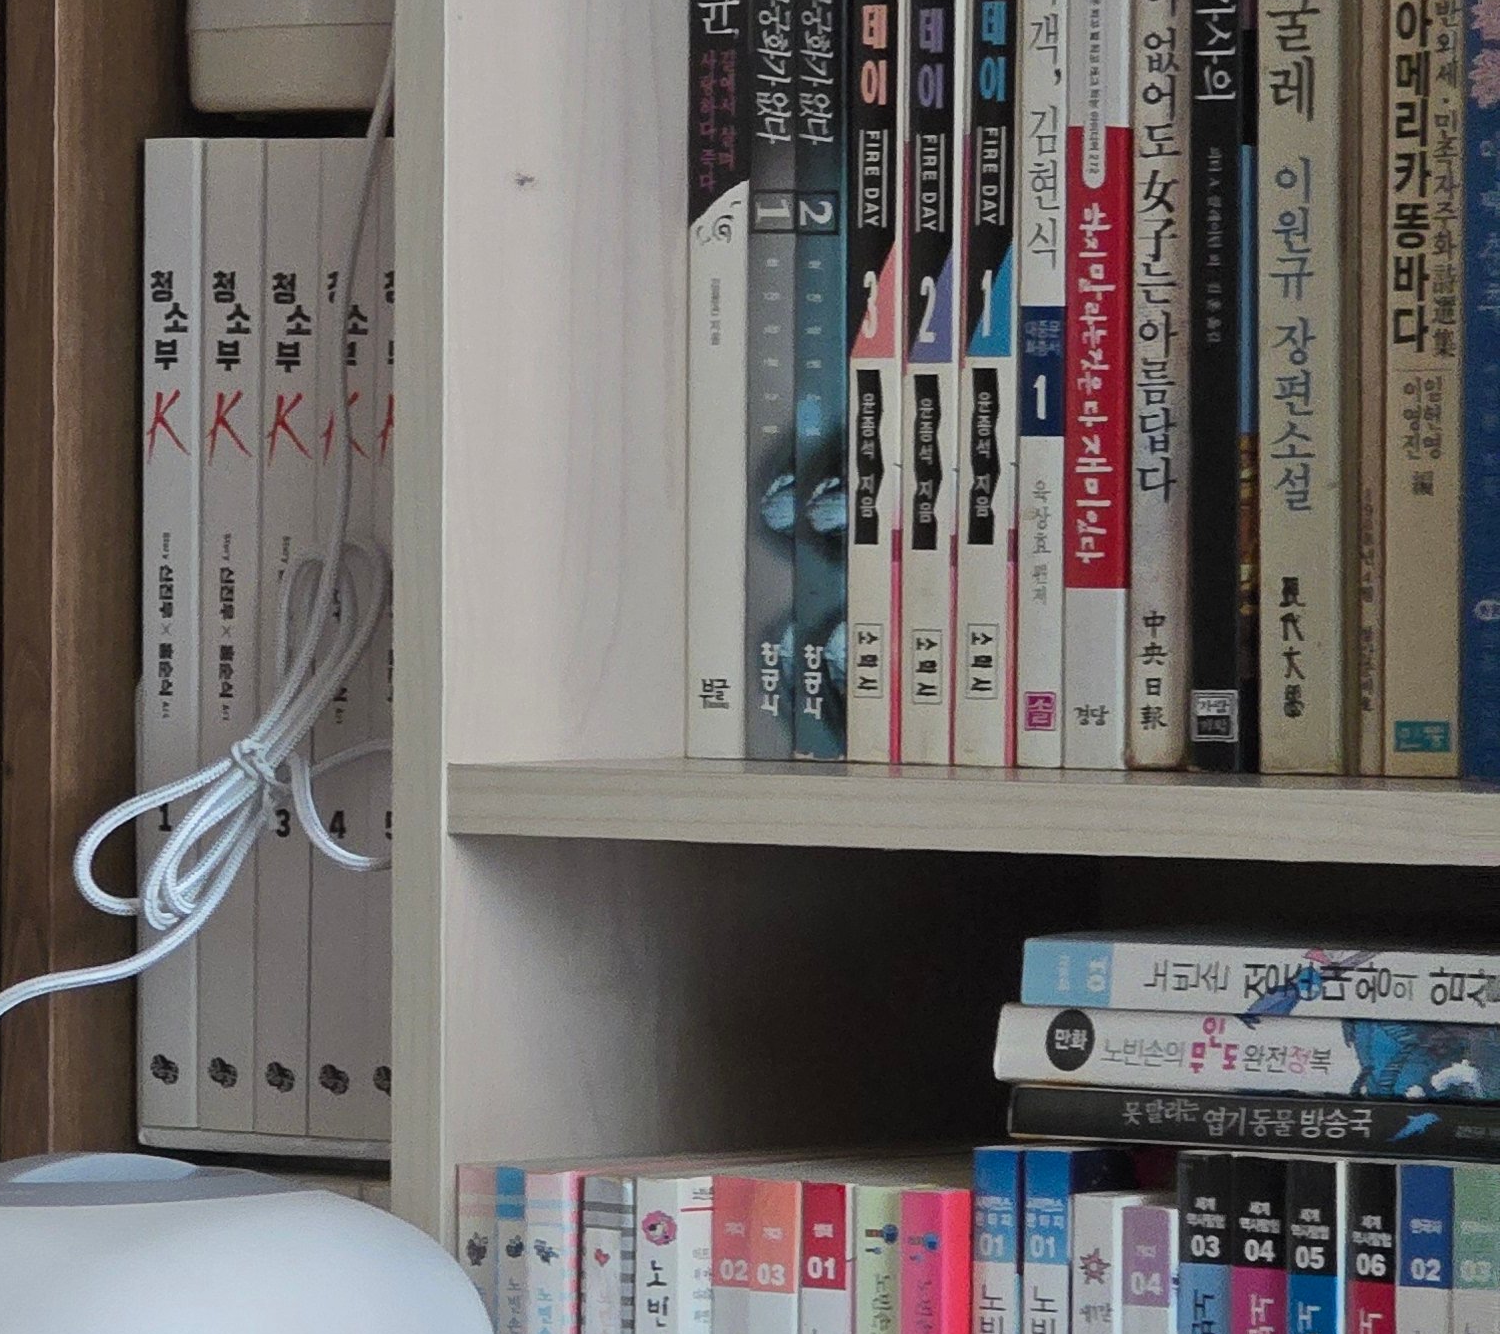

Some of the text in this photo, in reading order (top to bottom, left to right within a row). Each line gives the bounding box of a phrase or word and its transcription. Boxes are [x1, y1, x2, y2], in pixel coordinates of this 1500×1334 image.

[1139, 26, 1182, 158] 없어도
[863, 130, 880, 227] FIRE DAY
[921, 135, 938, 232] FIRE DAY
[981, 127, 998, 224] FIRE DAY
[1027, 106, 1060, 270] 김현식
[755, 199, 790, 222] 1
[800, 200, 834, 226] 2
[1269, 156, 1315, 301] 이원규
[863, 271, 878, 339] 3
[919, 276, 936, 343] 2
[982, 270, 992, 337] 1
[147, 270, 192, 465] 청소부 K
[206, 270, 252, 465] 청소부 K
[267, 273, 313, 466] 청소부 K
[1075, 203, 1116, 564] 하지 말라는 것은 다 재미있다
[1033, 375, 1047, 420] 1
[1135, 310, 1179, 504] 아름답다
[1270, 317, 1317, 512] 장편소설
[860, 475, 874, 519] 지음
[918, 481, 932, 523] 지음
[976, 474, 990, 518] 지음
[1140, 610, 1169, 730] 中央日報
[1027, 694, 1054, 728] 솔
[1074, 705, 1109, 726] 경당
[159, 803, 172, 831] 1
[277, 810, 290, 837] 3
[330, 810, 346, 838] 4
[1144, 961, 1232, 993] 노빈손
[1055, 1028, 1332, 1075] 만화 노빈손의 완전정복
[1203, 1108, 1374, 1139] 엽기 동물 방송국
[979, 1234, 1003, 1258] 01
[1030, 1234, 1057, 1258] 01
[1191, 1236, 1220, 1258] 03
[1244, 1240, 1275, 1262] 04
[1296, 1246, 1325, 1269] 05
[1356, 1254, 1386, 1276] 06
[719, 1260, 748, 1282] 02
[757, 1264, 785, 1286] 03
[807, 1257, 836, 1280] 01
[1131, 1273, 1161, 1296] 04
[1411, 1258, 1441, 1281] 02
